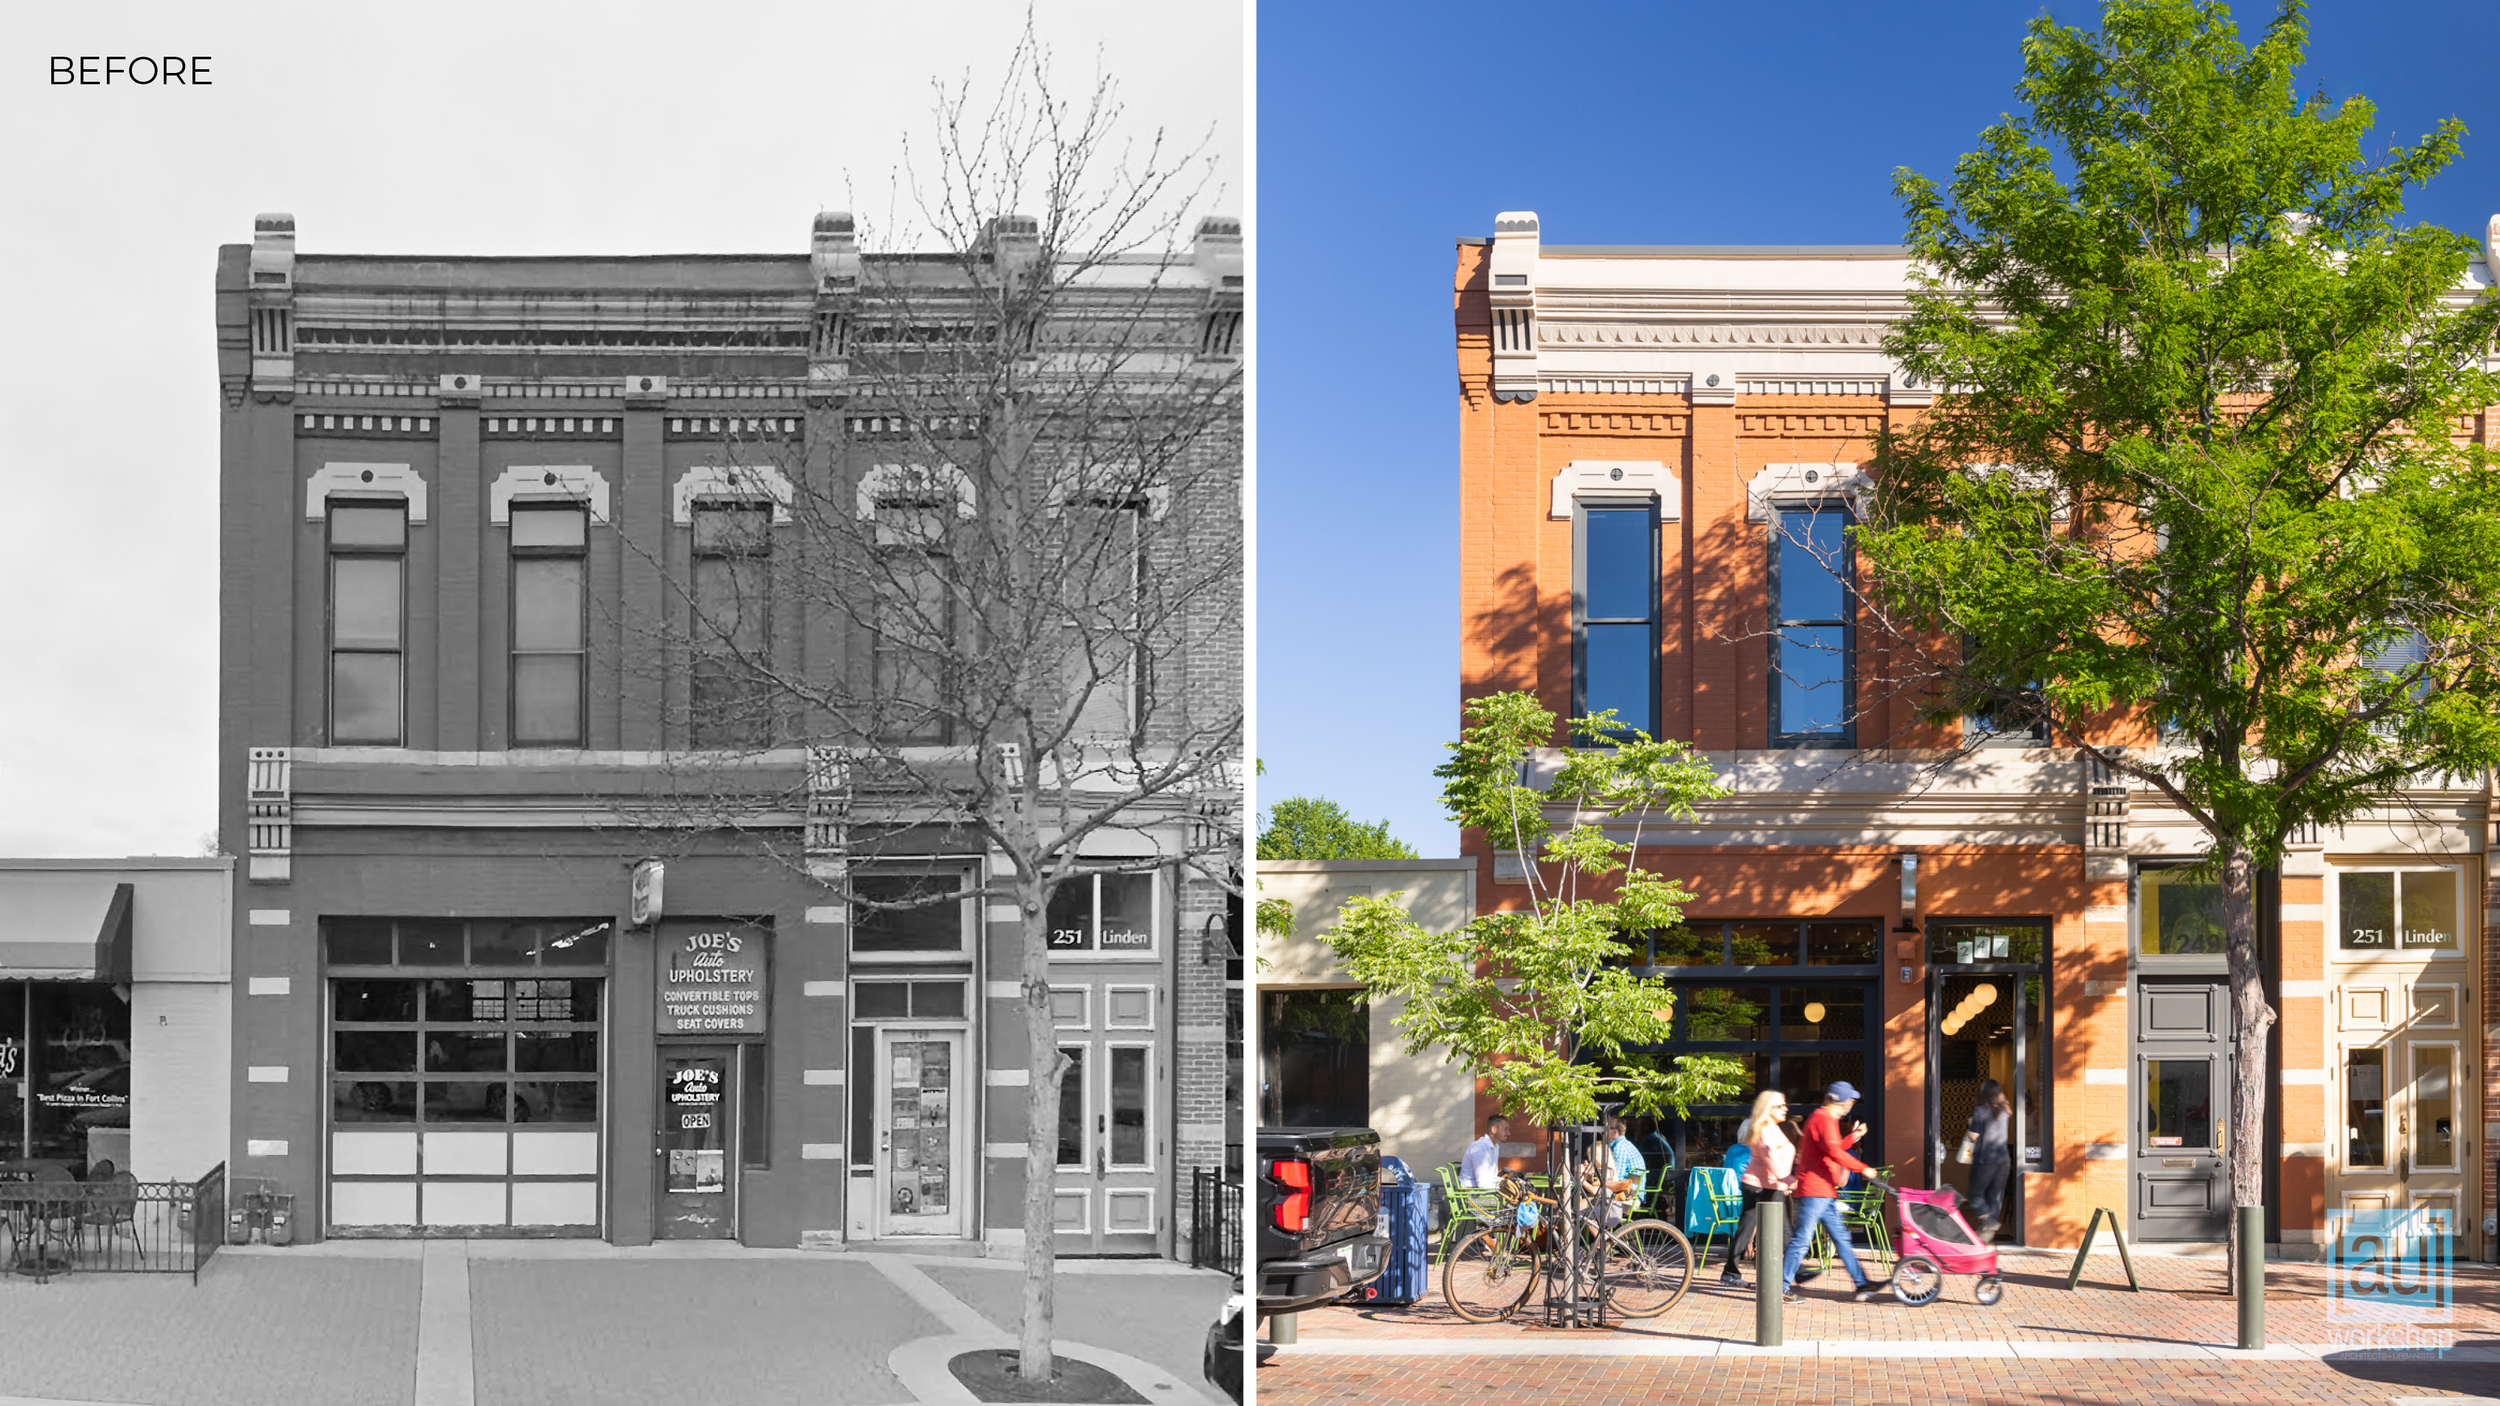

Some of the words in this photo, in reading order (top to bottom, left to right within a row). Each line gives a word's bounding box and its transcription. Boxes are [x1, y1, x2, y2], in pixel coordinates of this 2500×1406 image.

[685, 931, 743, 952] JOE'S
[1053, 929, 1082, 944] 251
[1103, 929, 1148, 944] Linden
[2352, 929, 2383, 944] 251
[2405, 928, 2452, 943] Linden
[2176, 933, 2222, 954] 249
[692, 950, 725, 967] Auto
[669, 969, 755, 983] UPHOLSTERY
[664, 991, 731, 1001] CONVERTIBLE
[733, 991, 759, 1001] TOPS
[667, 1005, 701, 1015] TRUCK
[702, 1005, 754, 1015] CUSHIONS
[677, 1019, 703, 1029] SEAT
[704, 1018, 744, 1029] COVERS
[673, 1069, 719, 1084] JOE'S
[671, 1093, 720, 1102] UPHOLSTERY
[683, 1115, 710, 1127] OPEN
